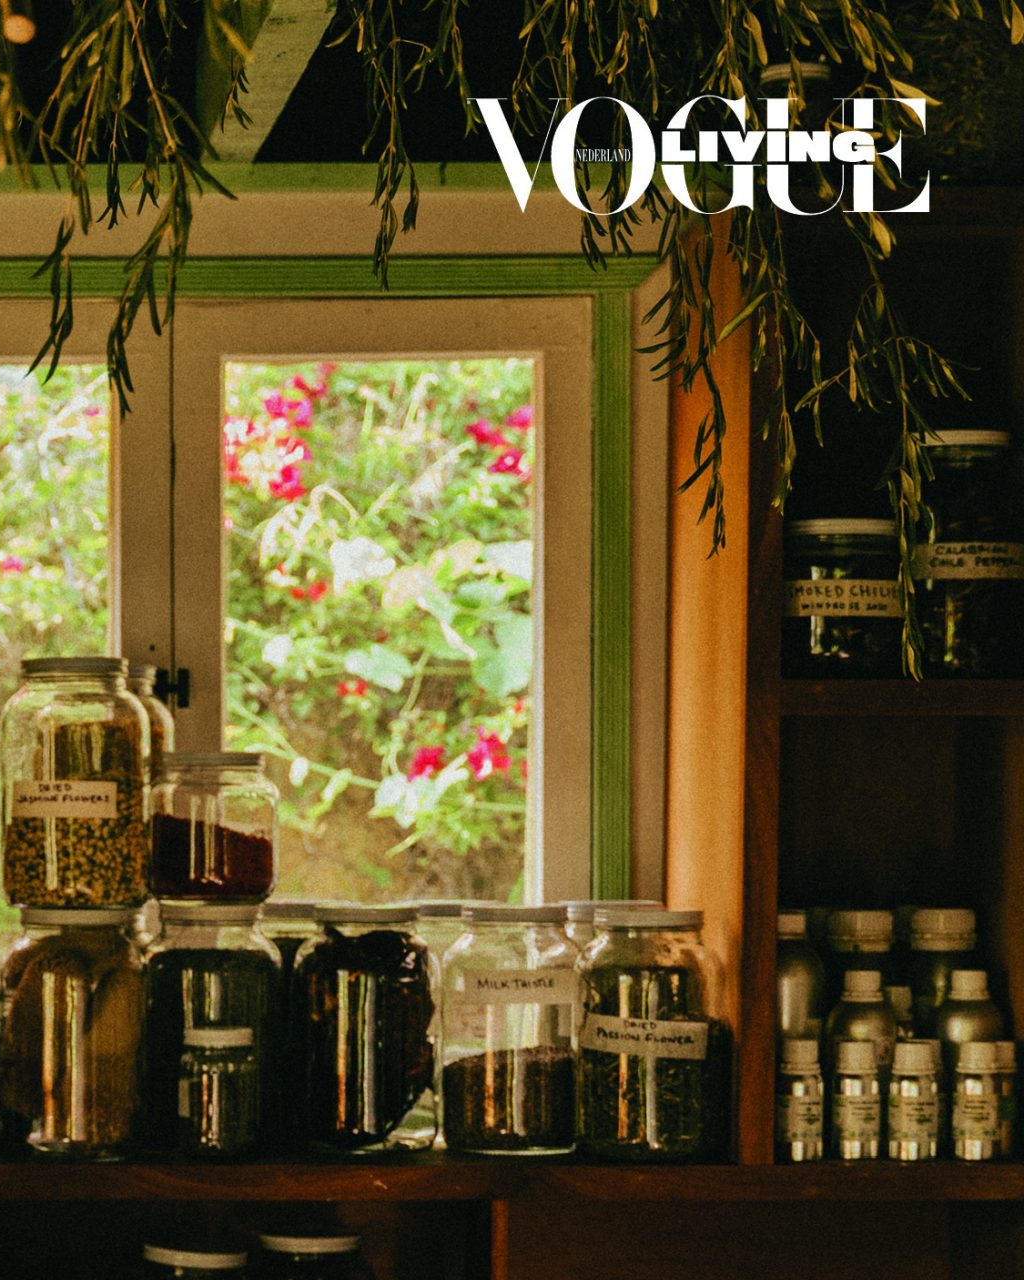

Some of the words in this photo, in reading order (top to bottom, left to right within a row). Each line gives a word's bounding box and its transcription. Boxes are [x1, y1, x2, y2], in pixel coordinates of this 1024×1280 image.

[787, 585, 844, 598] SMOKED
[38, 783, 71, 792] DRIED
[63, 795, 109, 803] FLOWERS
[476, 978, 509, 990] MILK
[512, 978, 554, 990] THISTLE
[623, 1020, 657, 1030] DRIED
[596, 1027, 640, 1041] PASSION
[645, 1033, 694, 1045] FLOWER
